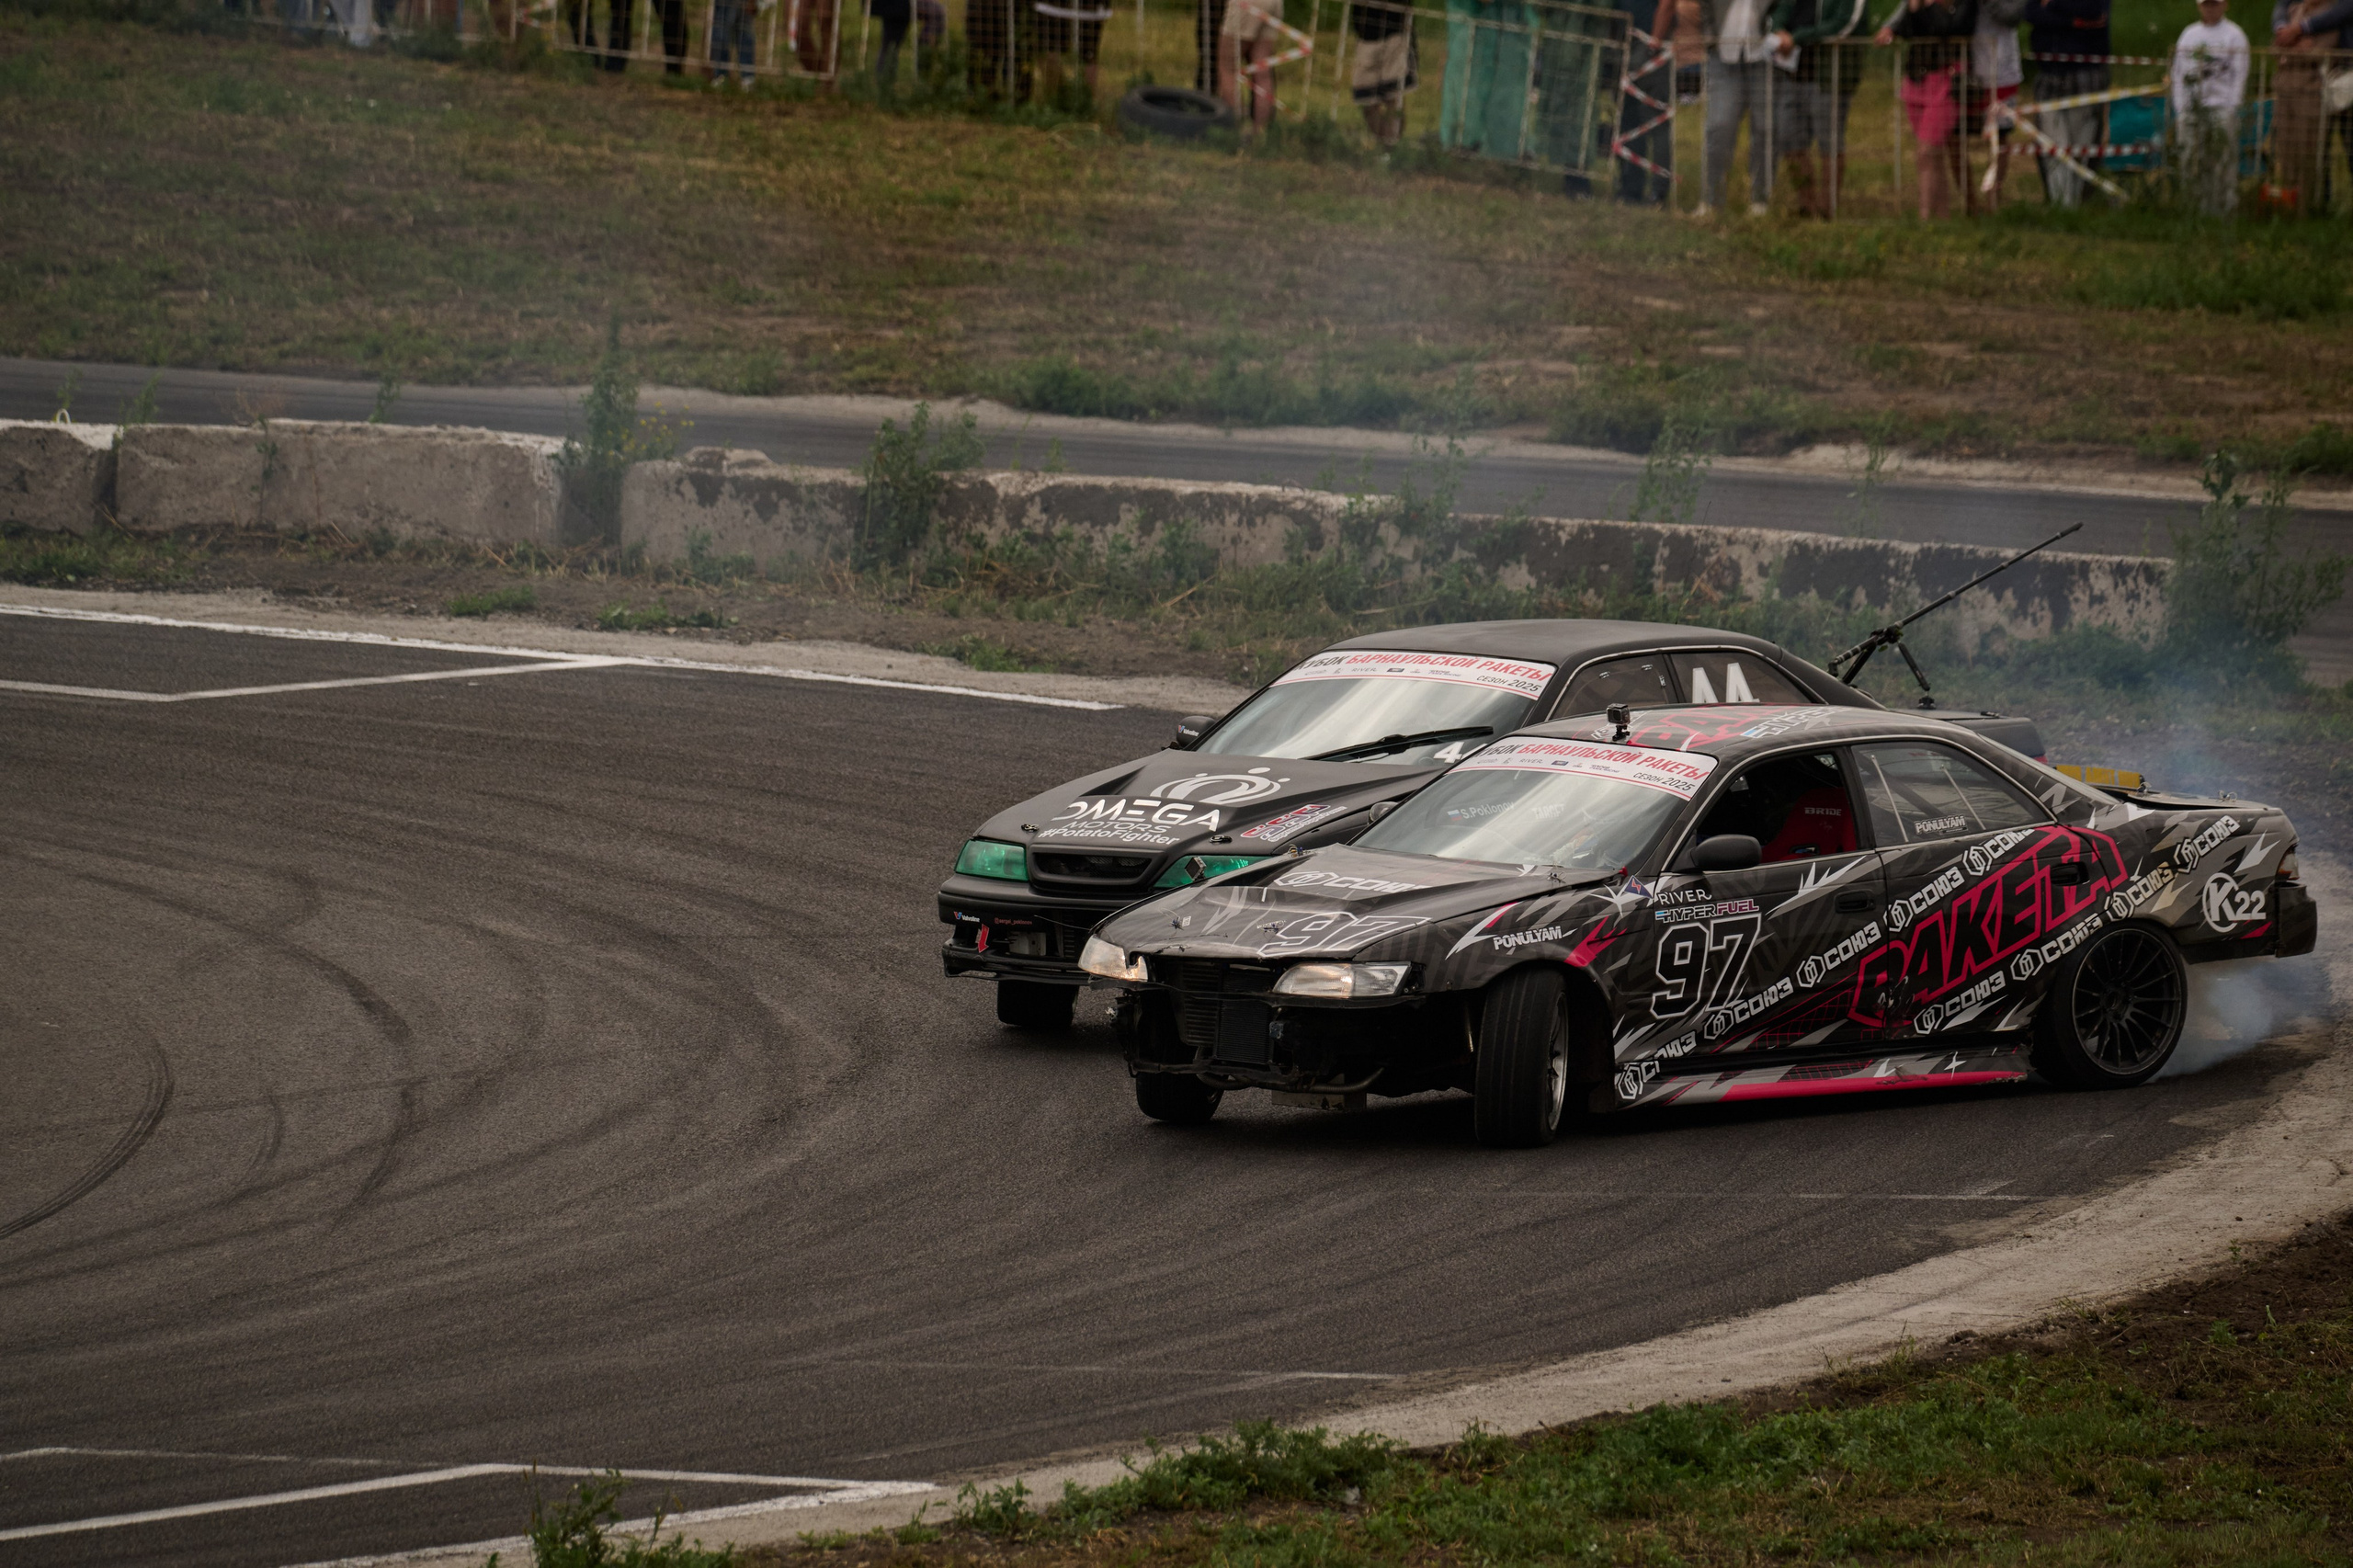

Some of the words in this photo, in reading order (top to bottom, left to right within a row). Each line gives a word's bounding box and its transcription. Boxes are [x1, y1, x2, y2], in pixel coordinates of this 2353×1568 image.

[1345, 653, 1478, 668] БАРНАУЛЬСКОЙ
[1477, 660, 1553, 682] РАКЕТЫ
[1476, 675, 1508, 685] СЕЗОН
[1507, 678, 1542, 693] 2025
[1517, 744, 1643, 764] БАРНАУЛЬСКОЙ
[1636, 756, 1711, 780] РАКЕТЫ
[1632, 772, 1663, 782] СЕЗОН
[1662, 777, 1696, 791] 2025
[1803, 807, 1843, 816] BRIDE
[1037, 827, 1181, 846] #PotatoFighter
[1061, 820, 1174, 835] MOTORS
[1657, 889, 1712, 905] RIVER
[1256, 911, 1433, 957] 97
[1493, 926, 1563, 950] PONULYAM
[1650, 912, 1763, 1019] 97
